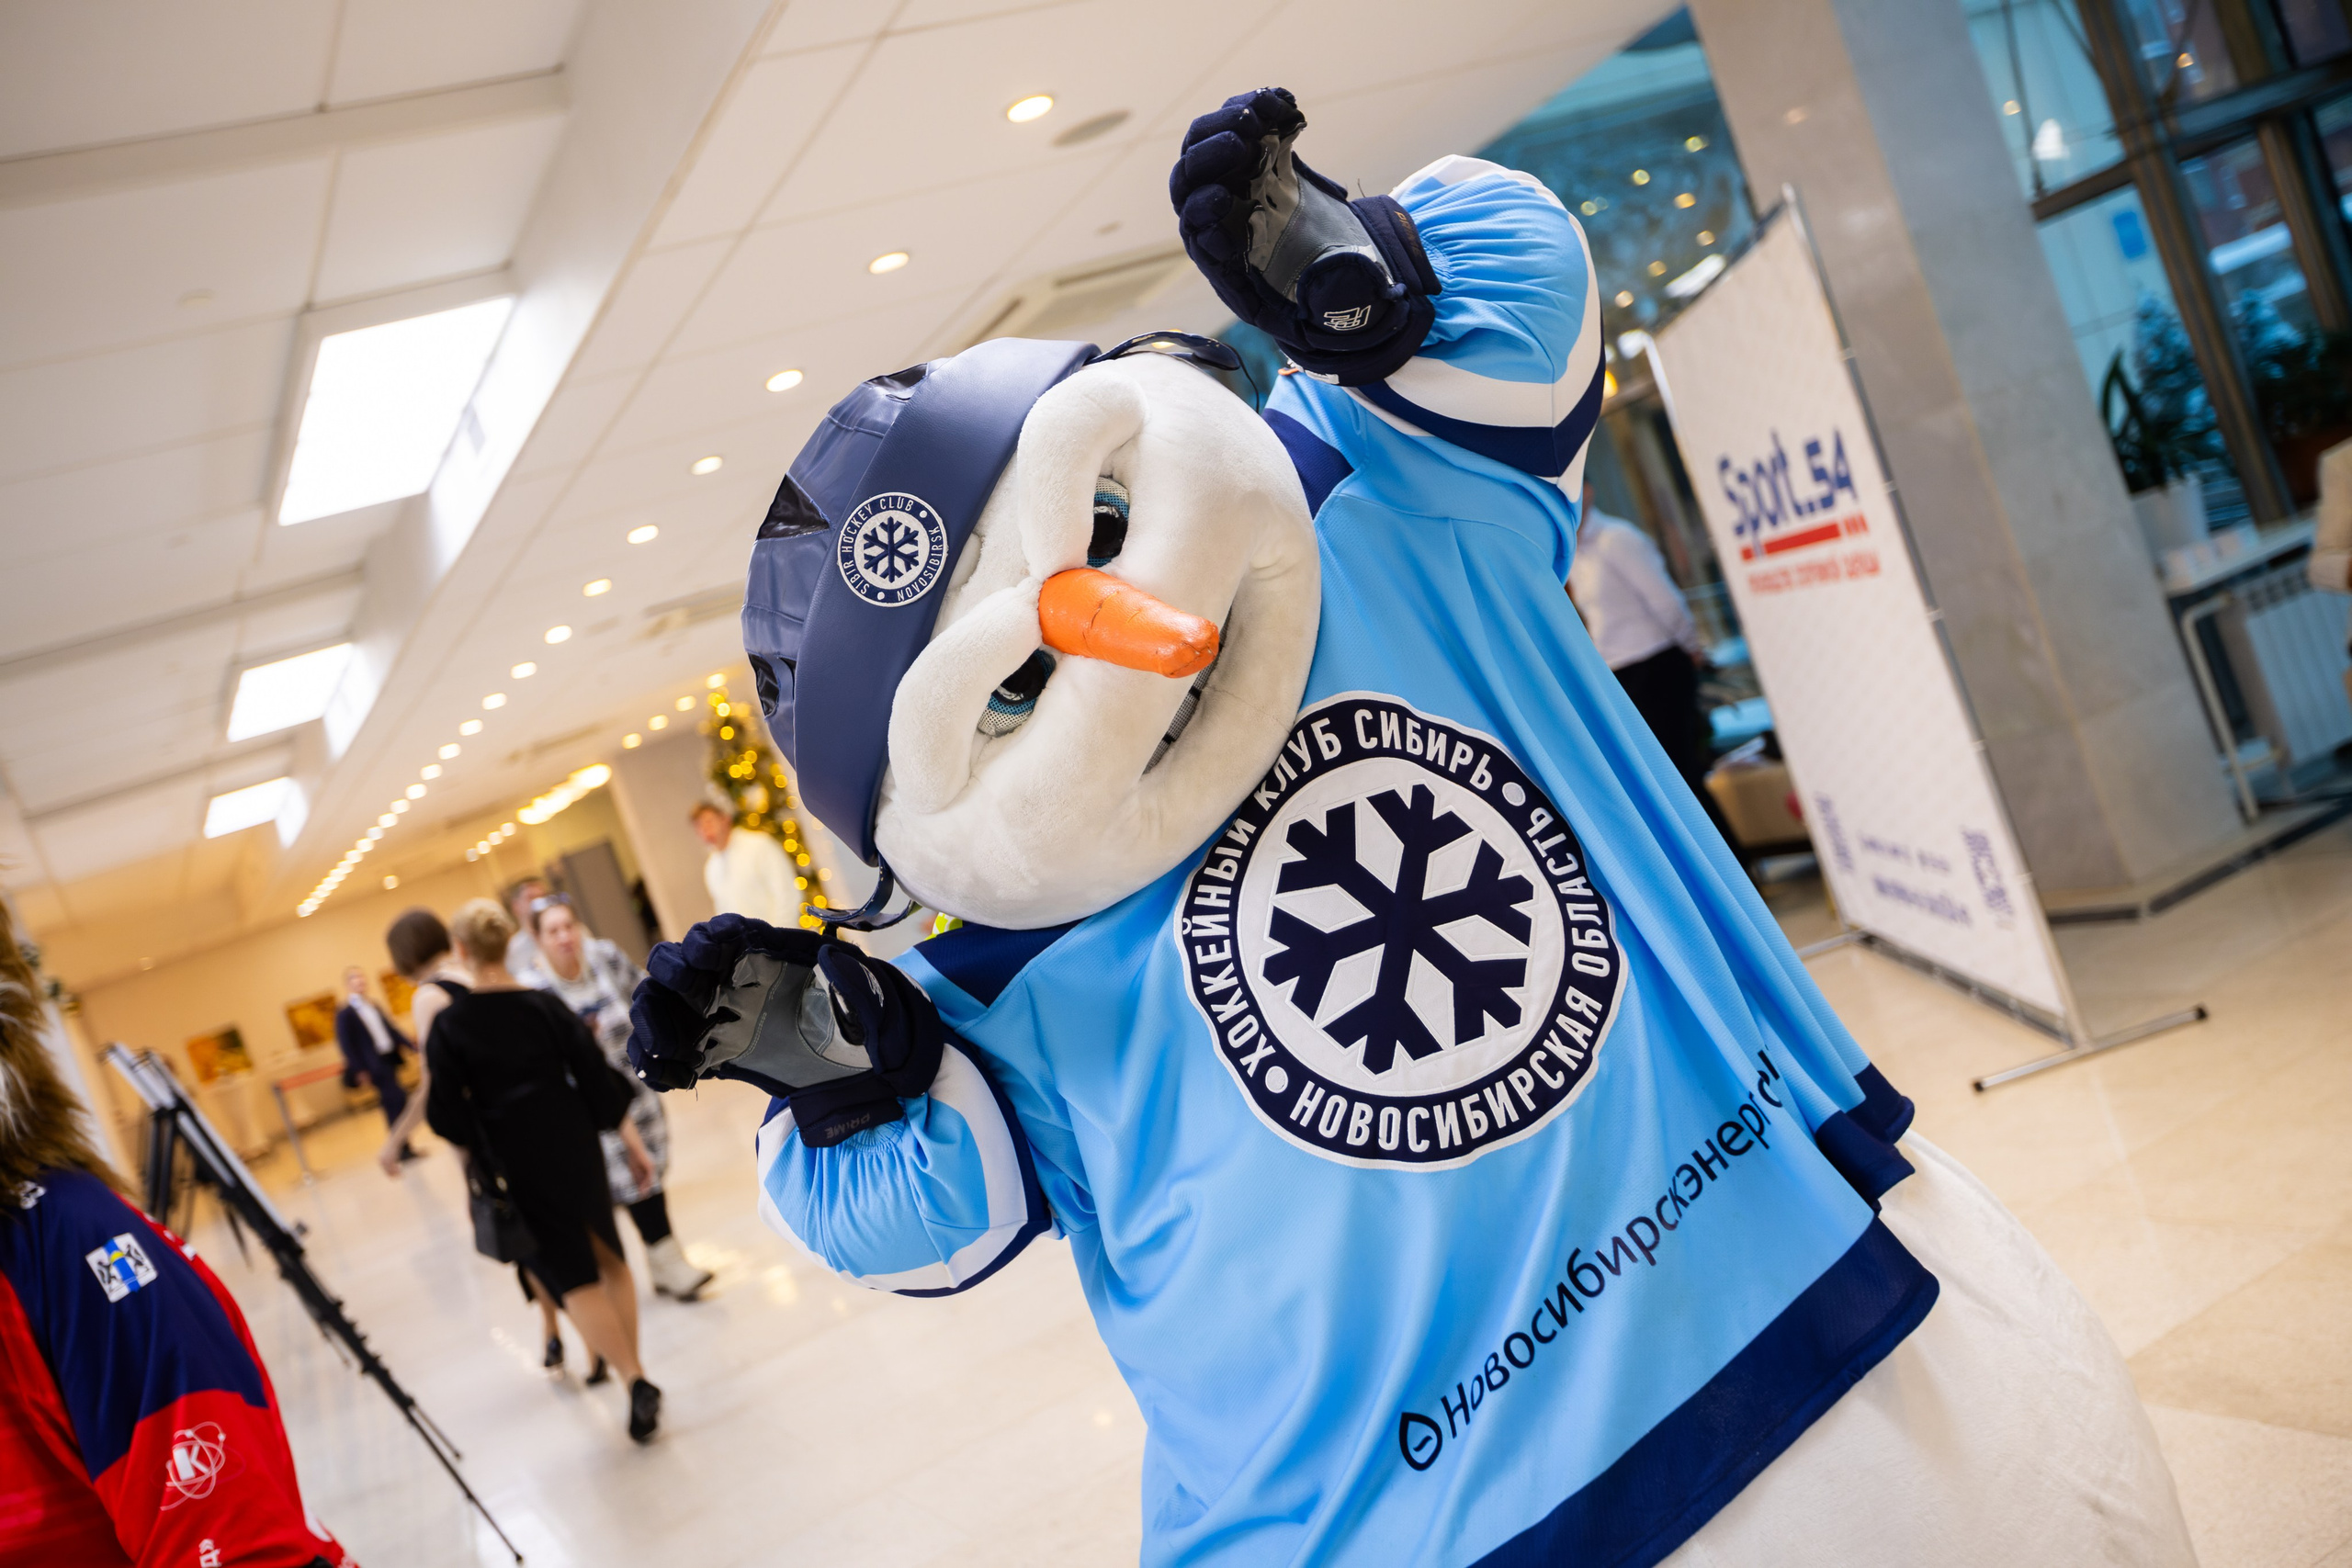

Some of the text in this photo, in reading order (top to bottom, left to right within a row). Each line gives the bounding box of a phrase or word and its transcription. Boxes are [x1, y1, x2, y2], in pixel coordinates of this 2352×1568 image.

[842, 497, 914, 595] SIBIR HOCKEY CLUB
[896, 525, 944, 602] NOVOSIBIRSK
[1182, 709, 1493, 1077] ХОККЕЙНЫЙ КЛУБ СИБИРЬ
[1290, 807, 1611, 1153] НОВОСИБИРСКАЯ ОБЛАСТЬ
[824, 1112, 871, 1139] PRIME
